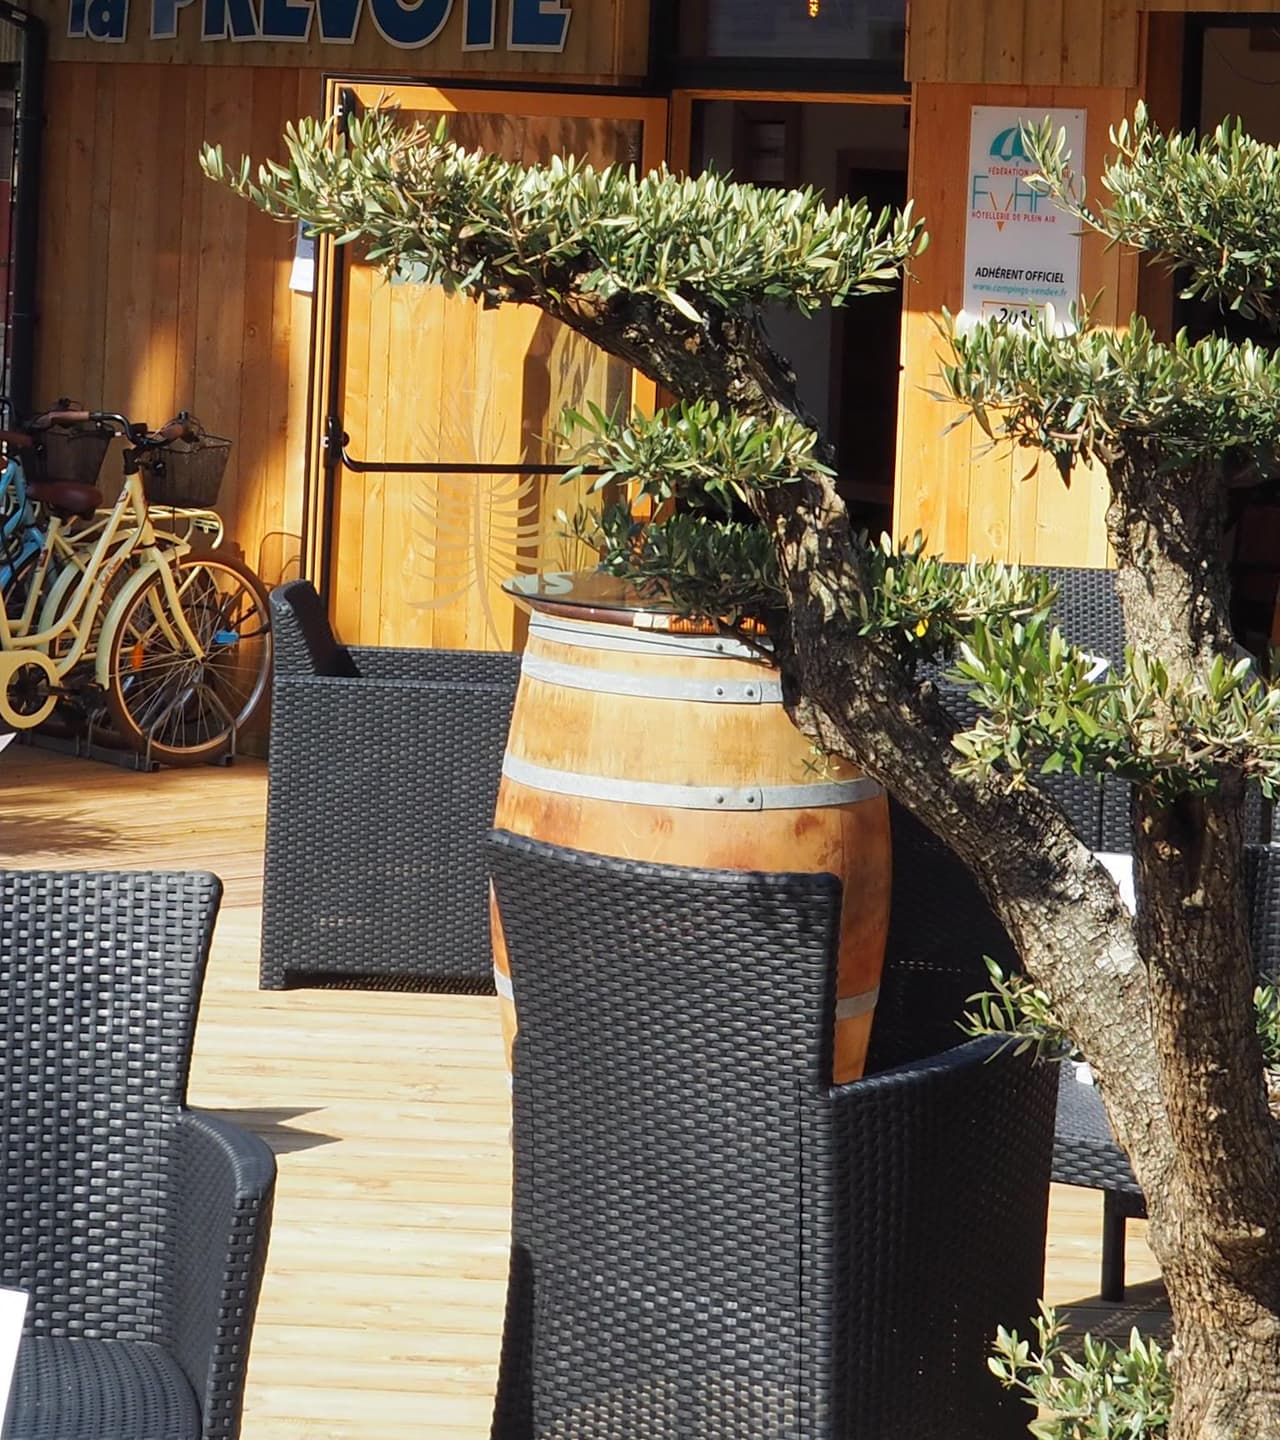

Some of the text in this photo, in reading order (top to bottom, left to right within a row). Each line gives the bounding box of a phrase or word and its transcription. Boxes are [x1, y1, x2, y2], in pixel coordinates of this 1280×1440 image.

[971, 210, 1056, 223] HÔTELLERIE DE PLEIN AIR
[975, 266, 1065, 284] ADHÉRENT OFFICIEL
